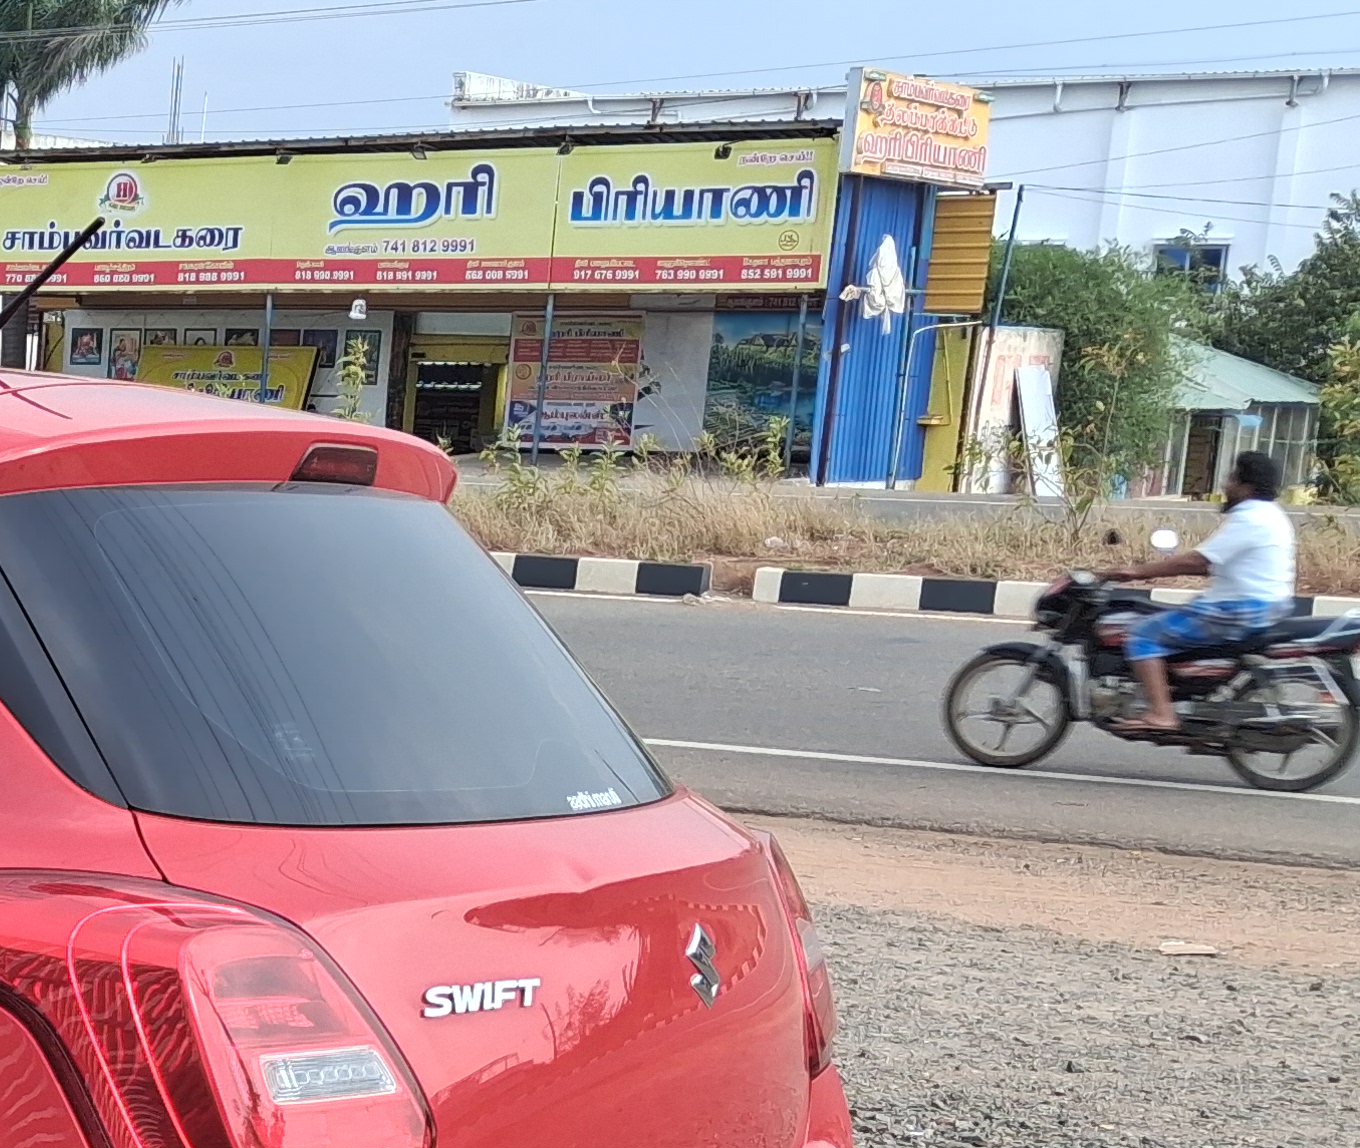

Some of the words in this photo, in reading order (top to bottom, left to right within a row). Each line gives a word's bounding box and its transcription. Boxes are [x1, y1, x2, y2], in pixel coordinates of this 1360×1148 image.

[329, 163, 495, 234] ஹரி
[570, 169, 816, 222] பிரியாணி
[383, 240, 406, 254] 741
[412, 240, 437, 253] 812
[442, 239, 475, 253] 9991
[424, 978, 541, 1018] SWIFT
